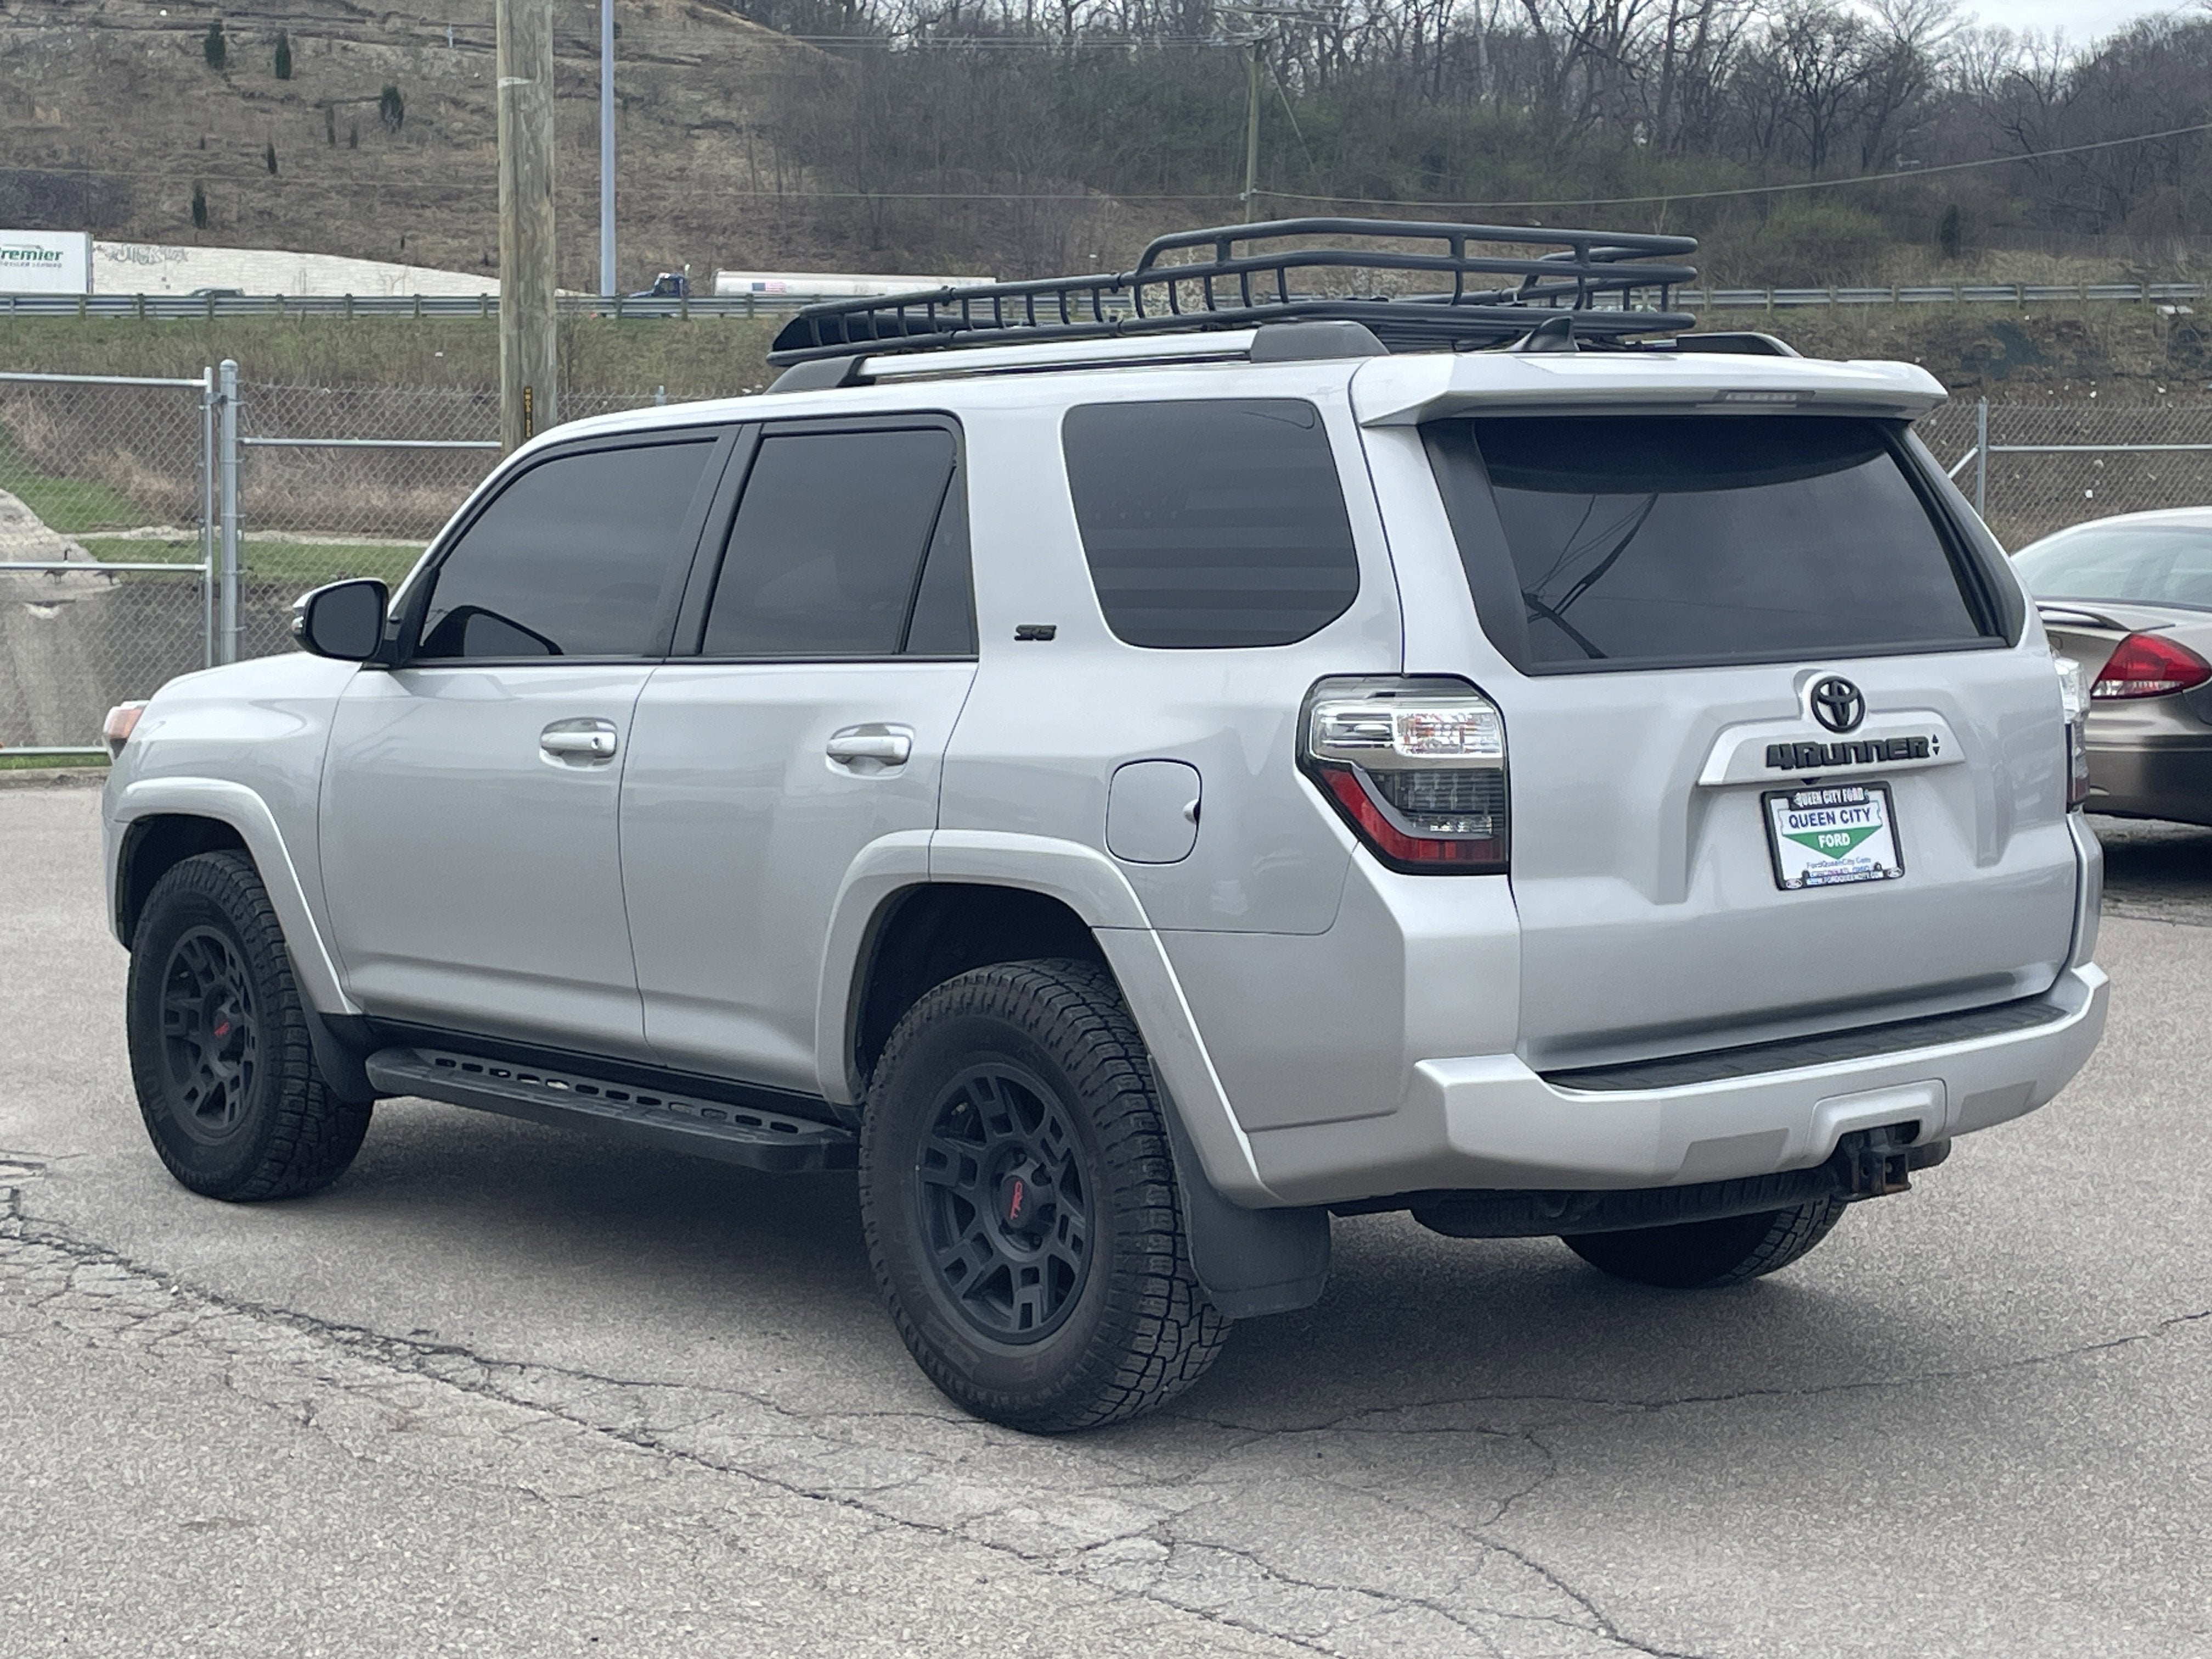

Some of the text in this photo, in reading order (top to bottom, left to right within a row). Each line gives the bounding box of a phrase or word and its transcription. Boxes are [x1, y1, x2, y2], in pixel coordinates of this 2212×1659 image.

[0, 249, 64, 261] remier
[1788, 808, 1871, 829] QUEEN CITY
[1818, 833, 1850, 849] FORD
